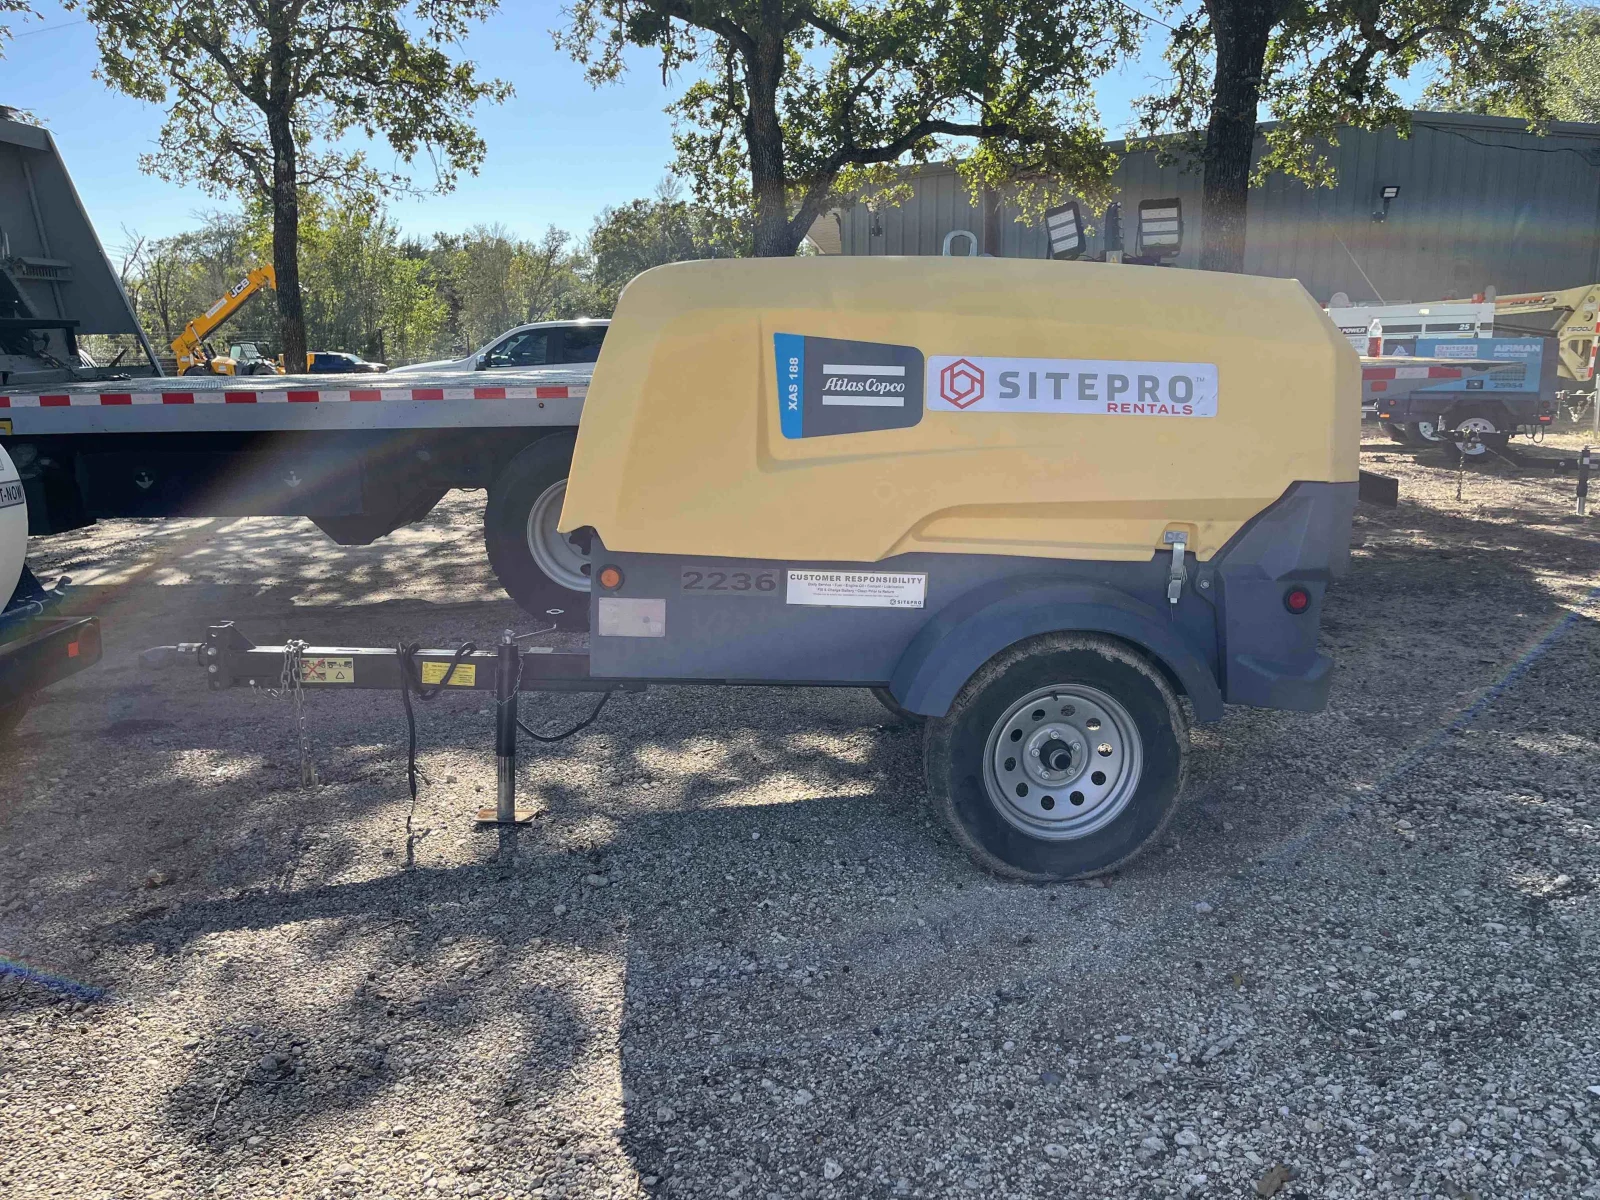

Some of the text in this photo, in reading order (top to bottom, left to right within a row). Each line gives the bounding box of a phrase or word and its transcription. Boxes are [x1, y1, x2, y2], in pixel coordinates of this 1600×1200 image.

[231, 278, 250, 298] JCB
[1494, 344, 1540, 352] AIRMAN
[788, 357, 798, 410] XAS 188
[822, 377, 906, 395] Atlas Copco
[998, 372, 1194, 404] SITEPRO
[1107, 402, 1193, 415] RENTALS
[683, 572, 776, 591] 2236
[790, 574, 923, 584] CUSTOMER RESPONSIBILITY
